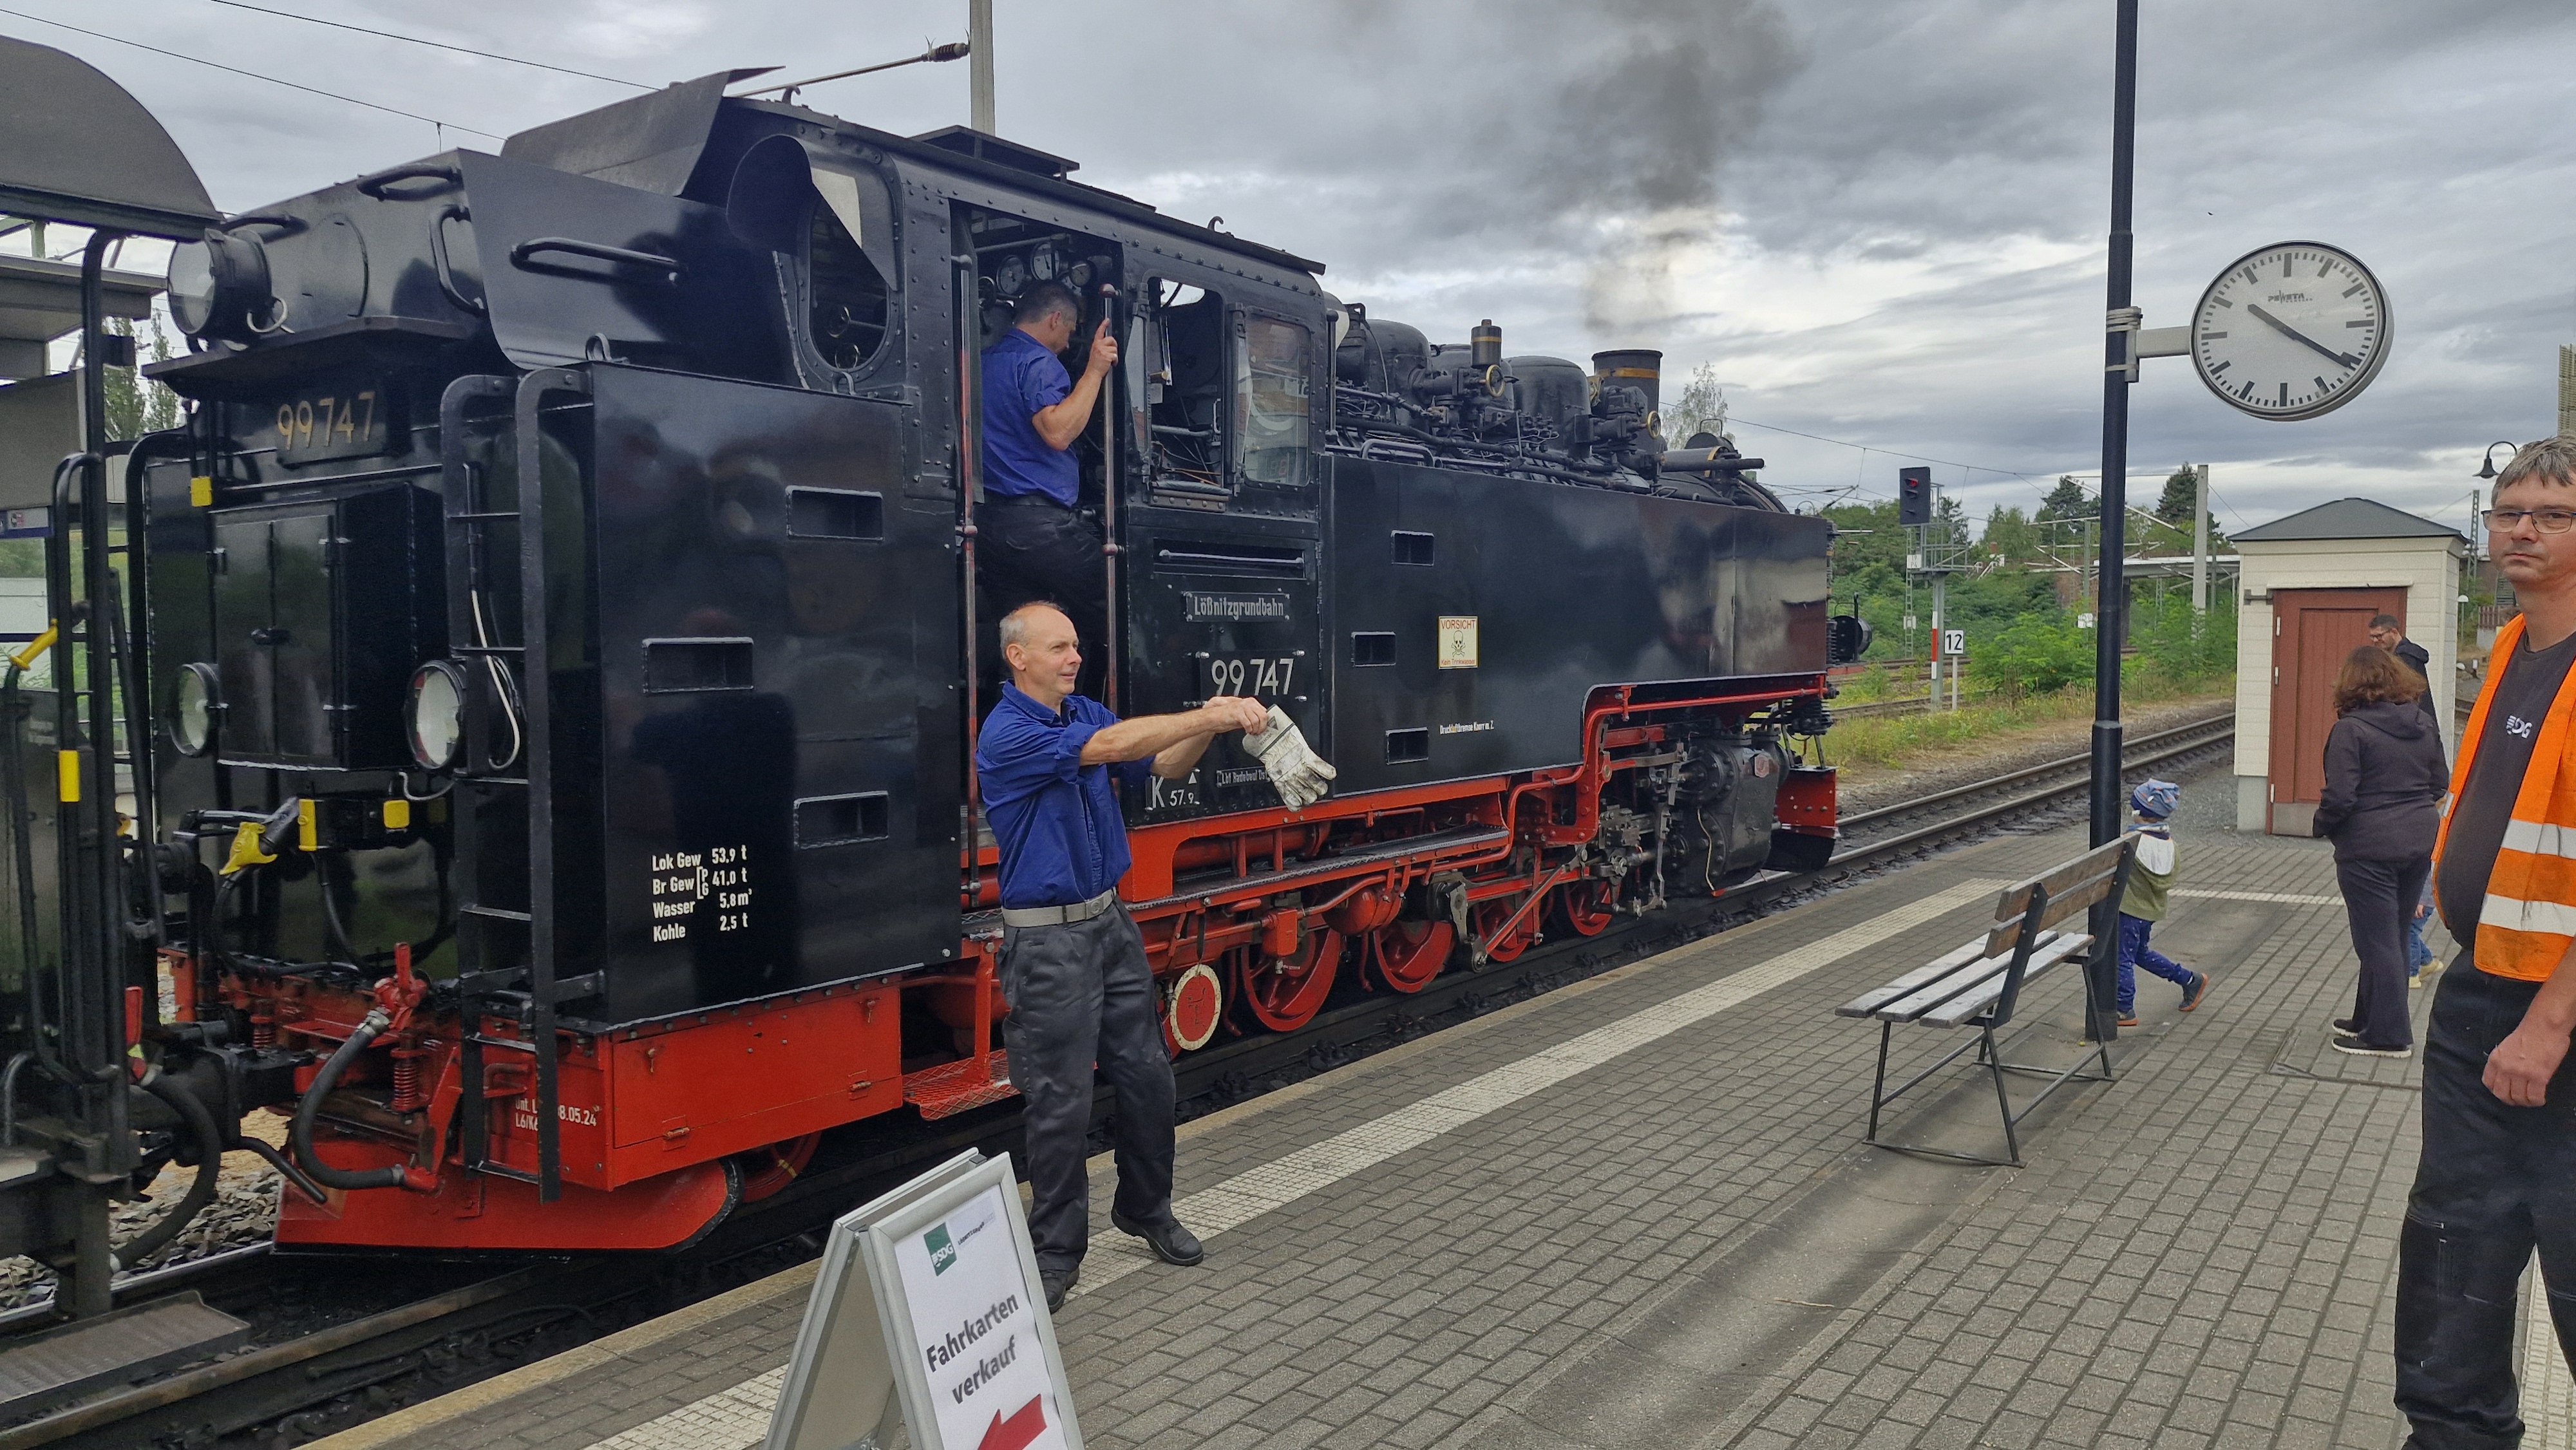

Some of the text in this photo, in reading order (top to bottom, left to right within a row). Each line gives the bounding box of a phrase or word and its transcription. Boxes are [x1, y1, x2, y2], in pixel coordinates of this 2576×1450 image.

[278, 391, 375, 450] 99 747
[1194, 596, 1283, 621] Lößnitzgrundbahn
[1441, 619, 1475, 629] VORSICHT
[1946, 634, 1962, 650] 12
[1211, 658, 1294, 697] 99 747
[1151, 776, 1165, 809] K
[652, 853, 674, 872] Lok
[676, 852, 701, 868] Gew
[741, 844, 747, 860] t
[652, 878, 667, 895] Br
[670, 876, 695, 892] Gew
[701, 869, 708, 882] P
[741, 867, 748, 882] t
[701, 882, 709, 896] G
[652, 901, 696, 919] Wasser
[653, 912, 748, 942] Kohle 2,5 t
[558, 1105, 596, 1127] 8.05.24
[936, 1243, 954, 1262] SDG
[926, 1294, 1019, 1373] Fahrkarten
[952, 1334, 1016, 1404] verkauf
